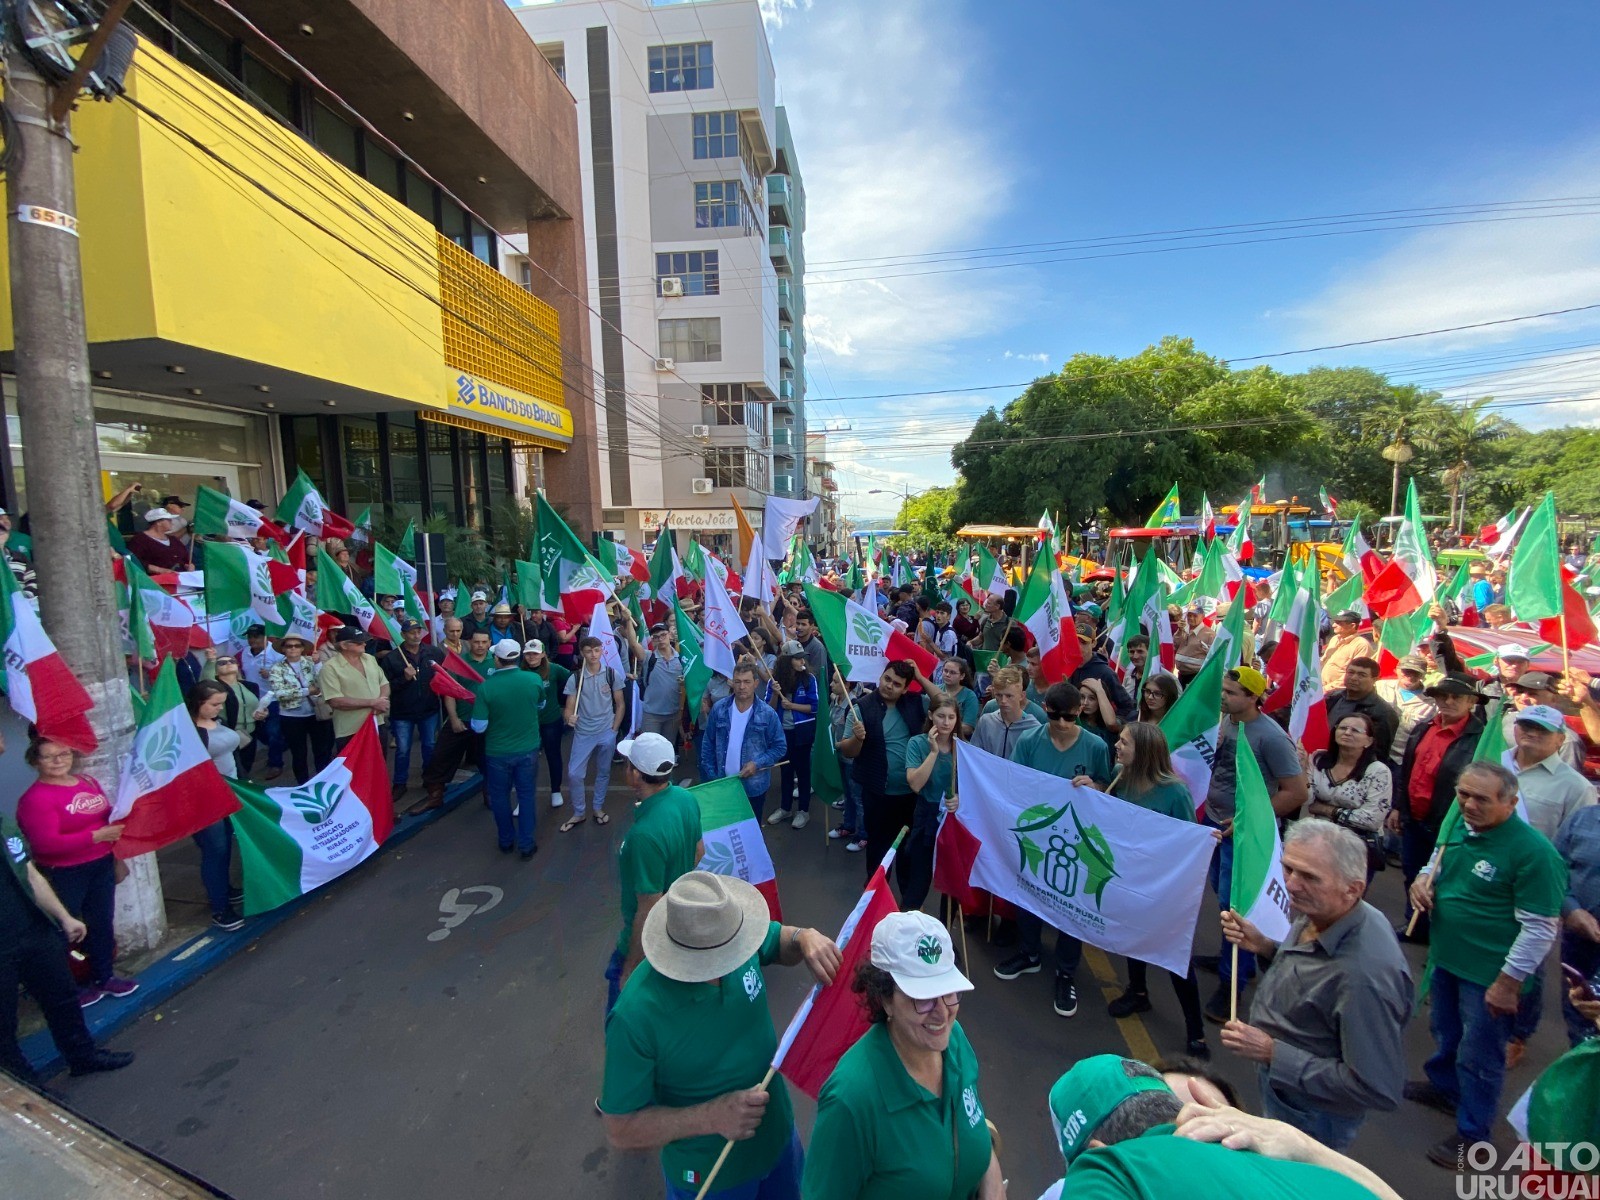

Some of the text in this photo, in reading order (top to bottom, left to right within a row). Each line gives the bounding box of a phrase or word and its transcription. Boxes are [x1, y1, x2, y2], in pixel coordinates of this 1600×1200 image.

[478, 384, 563, 429] BANCO DO BRASIL
[704, 512, 734, 527] João
[326, 837, 348, 852] RURAIS
[1075, 906, 1106, 926] RURAL
